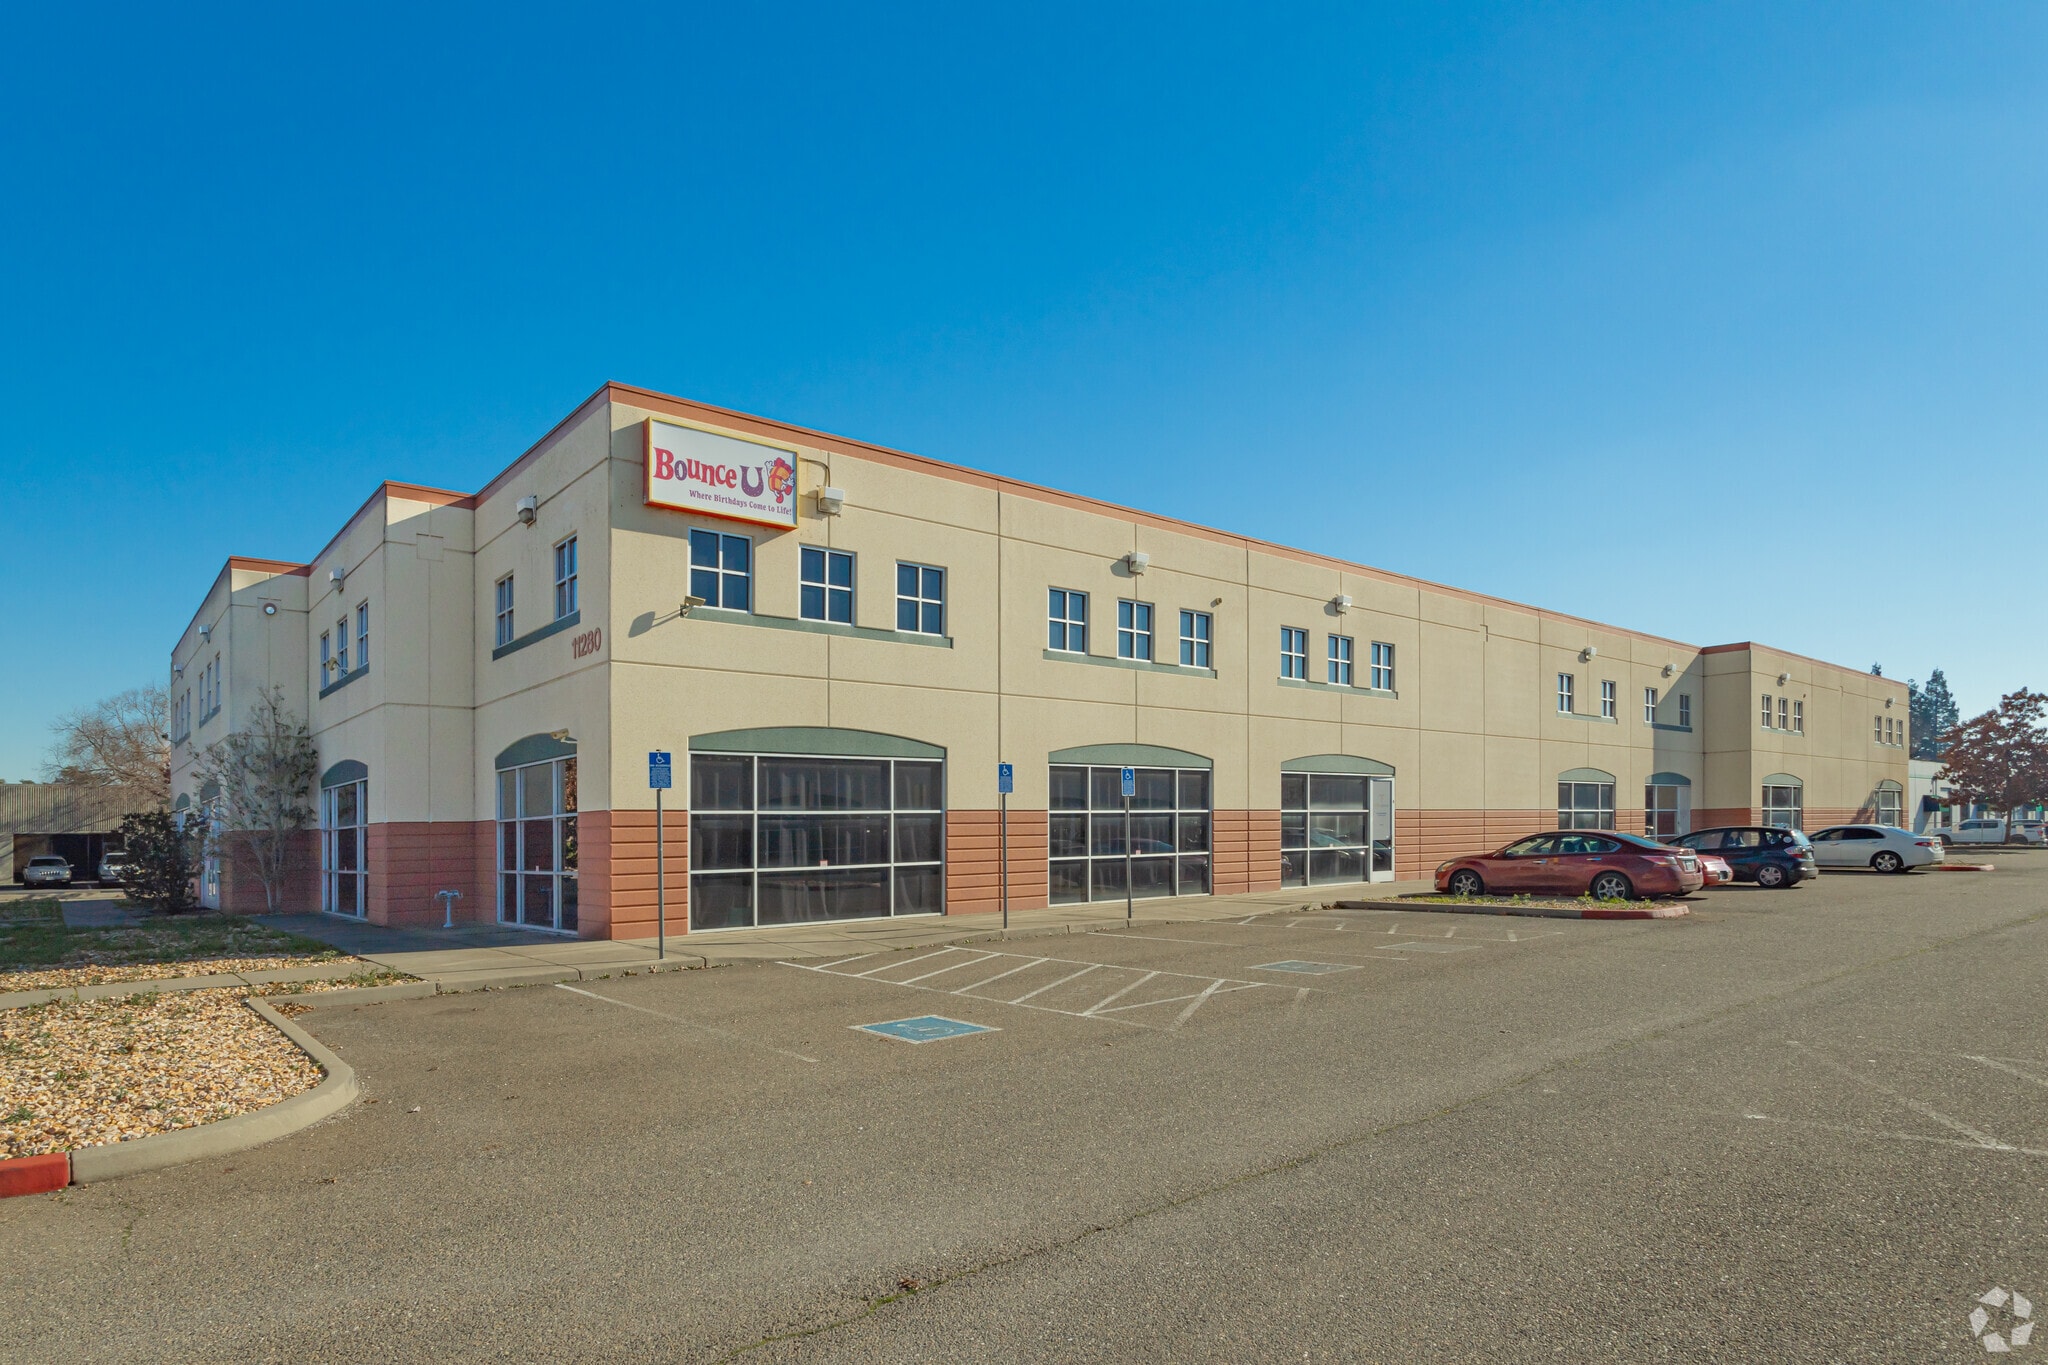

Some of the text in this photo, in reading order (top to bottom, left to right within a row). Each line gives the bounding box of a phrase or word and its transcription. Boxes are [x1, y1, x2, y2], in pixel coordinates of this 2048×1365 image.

[653, 447, 764, 498] Bounce U
[689, 489, 712, 501] Where
[714, 494, 747, 508] Birthdays
[749, 501, 766, 511] Come
[777, 506, 792, 516] Life!
[572, 627, 602, 660] 11280
